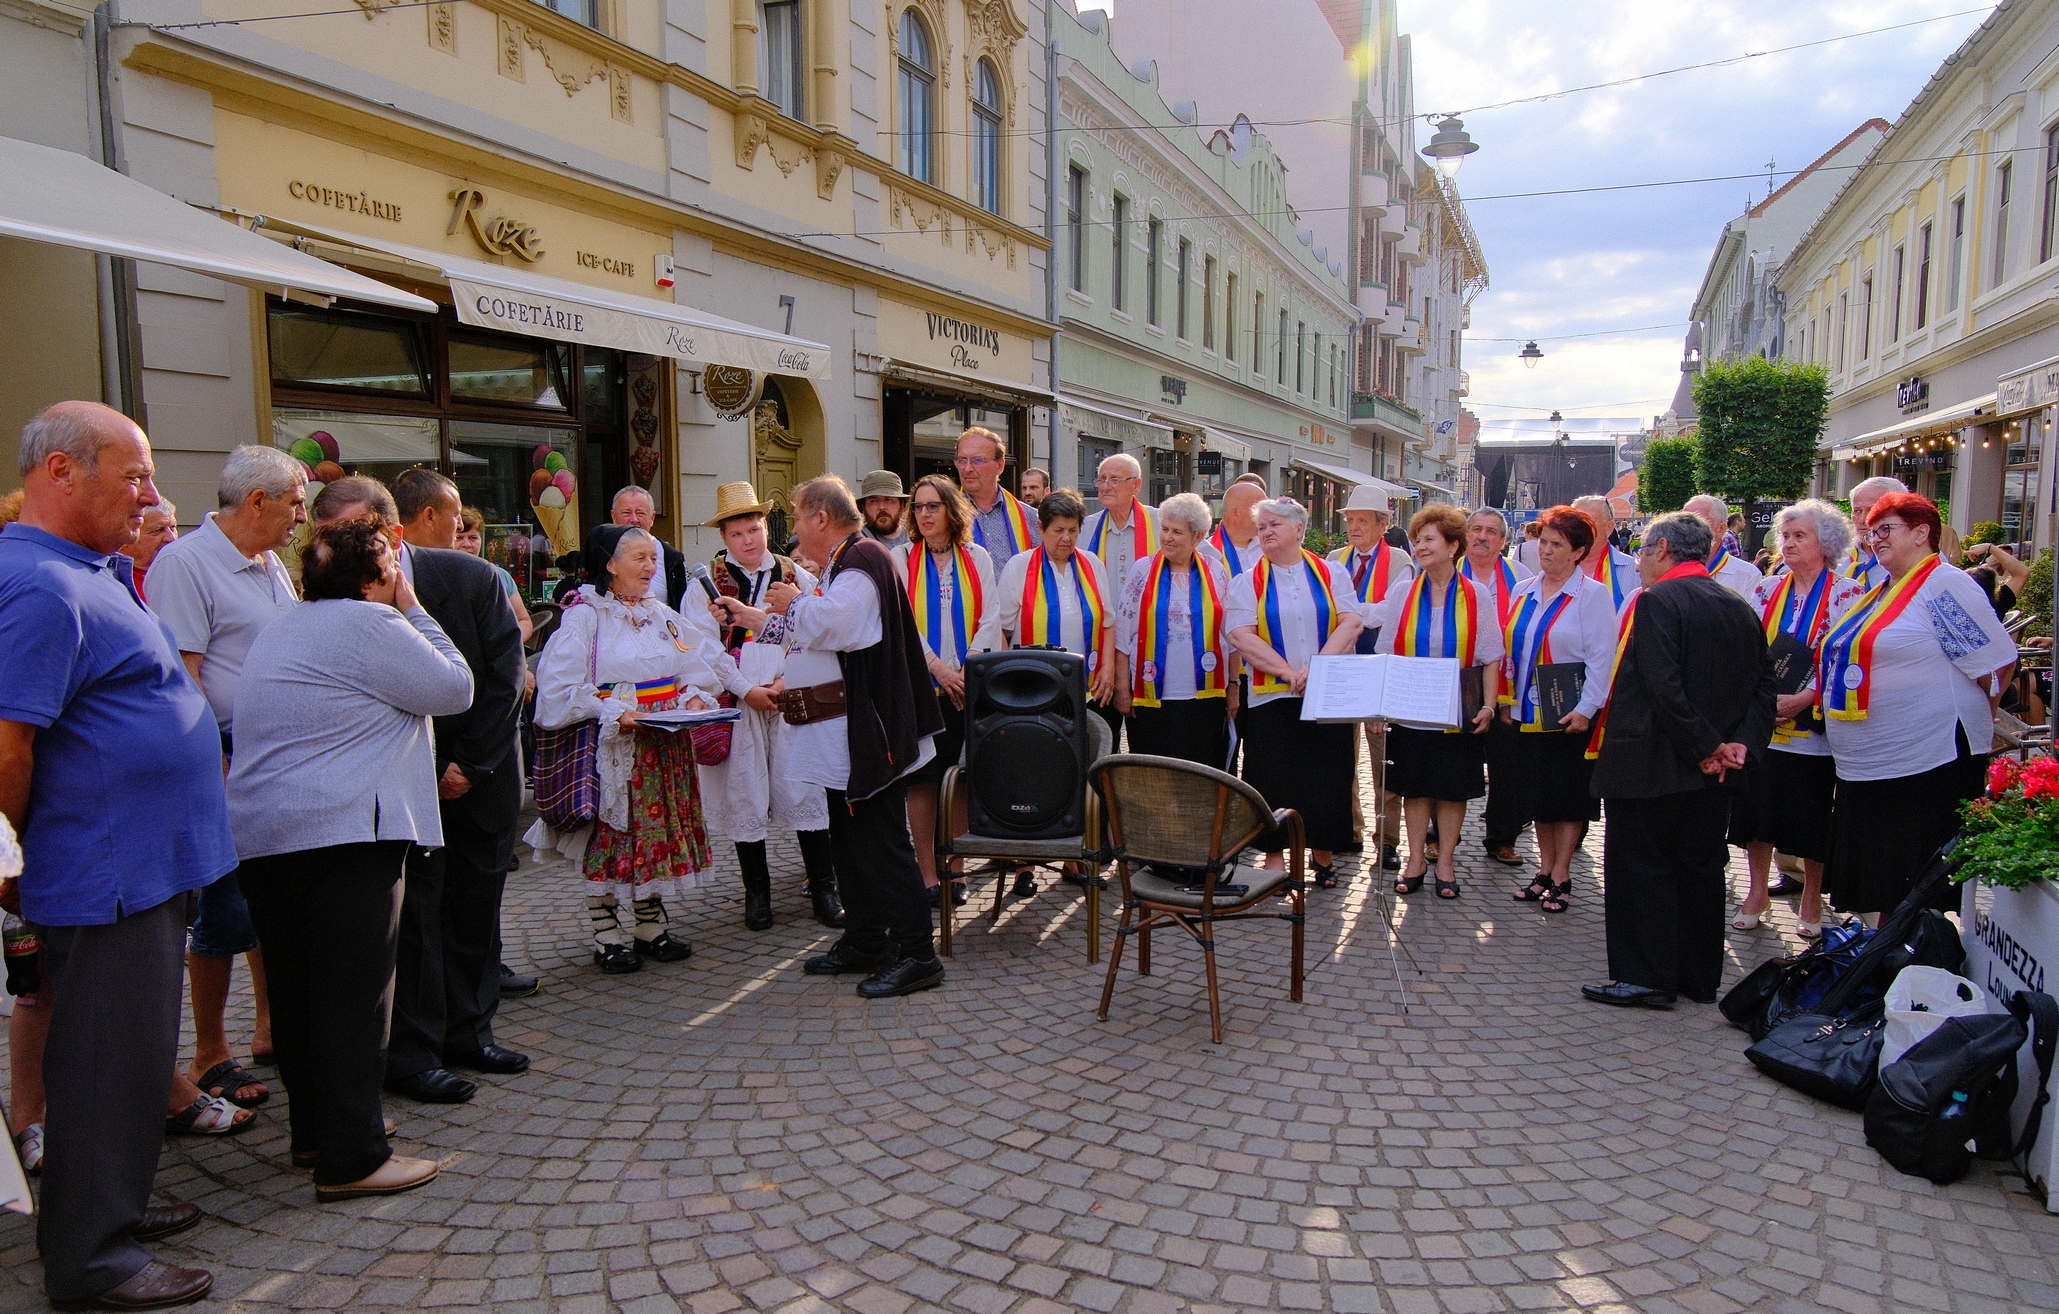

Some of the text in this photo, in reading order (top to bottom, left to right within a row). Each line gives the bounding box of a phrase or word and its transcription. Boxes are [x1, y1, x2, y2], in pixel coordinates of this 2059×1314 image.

[447, 188, 546, 264] Roze
[476, 295, 584, 332] COFETĂRIE
[666, 326, 697, 355] Roze
[926, 311, 1000, 357] VICTORIA'S
[712, 365, 745, 385] Roze
[950, 344, 980, 370] Place
[1975, 911, 2044, 993] GRANDEZZA
